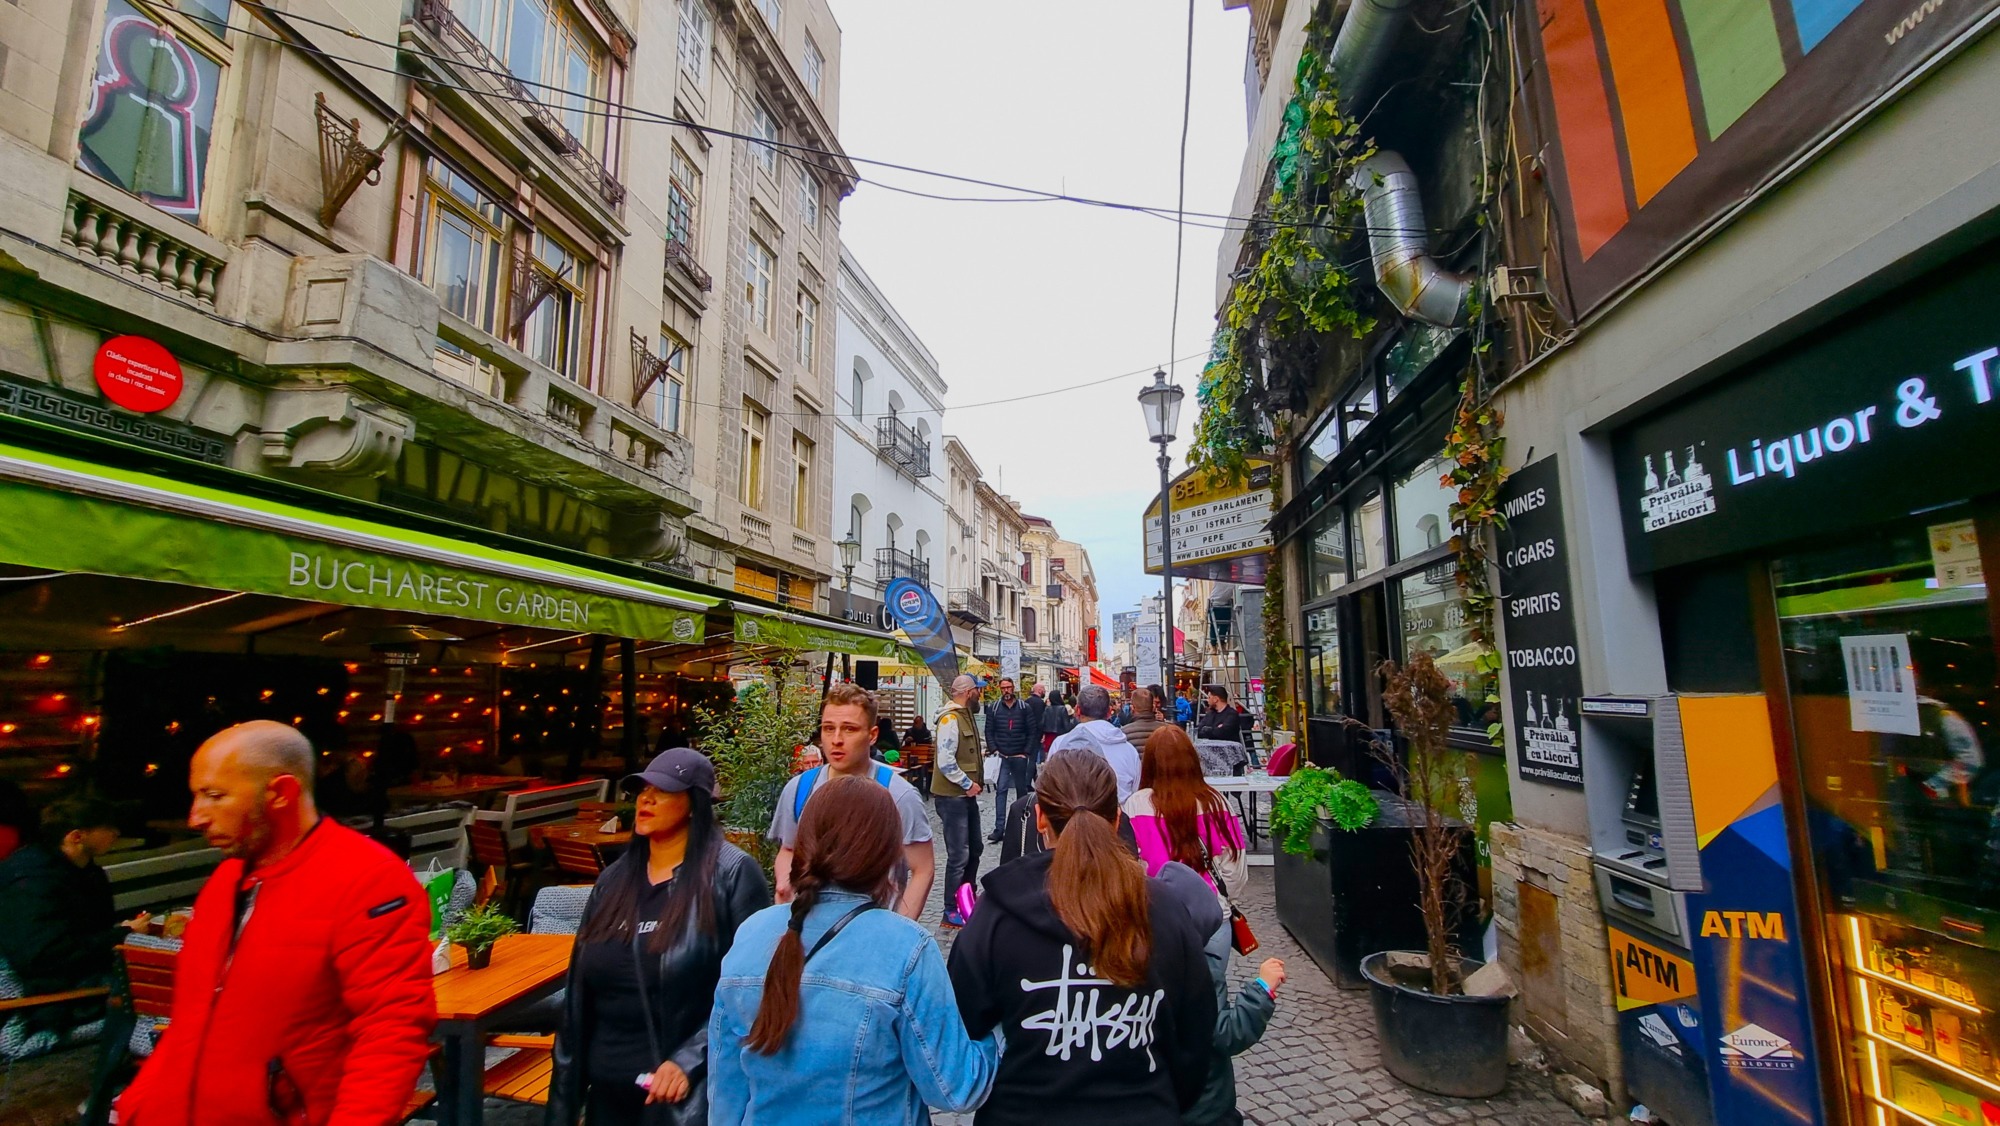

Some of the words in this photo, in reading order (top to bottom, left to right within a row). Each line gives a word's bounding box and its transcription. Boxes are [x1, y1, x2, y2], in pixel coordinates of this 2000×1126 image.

[115, 374, 130, 384] clasa
[134, 380, 144, 389] risc
[144, 384, 166, 396] seismic
[1726, 404, 1877, 486] Liquor
[1896, 377, 1942, 428] &
[1953, 346, 2000, 405] T
[1504, 487, 1546, 520] WINES
[1649, 482, 1704, 508] Prăvălia
[1171, 513, 1181, 524] 29
[1191, 508, 1207, 518] RED
[1213, 494, 1264, 513] PARLAMENT
[1651, 517, 1666, 528] cu
[1668, 500, 1708, 522] Licori
[1185, 525, 1198, 534] ADI
[1206, 513, 1242, 528] ISTRATE
[1177, 540, 1187, 550] 24
[1203, 533, 1224, 544] PEPE
[1506, 538, 1555, 568] CIGARS
[288, 552, 490, 610] BUCHAREST
[495, 587, 589, 624] GARDEN
[1511, 592, 1560, 618] SPIRITS
[1509, 645, 1576, 668] TOBACCO
[1531, 750, 1542, 759] cu
[1543, 750, 1573, 764] Licori
[1701, 910, 1785, 941] ATM
[1626, 941, 1681, 994] ATM
[1644, 1017, 1674, 1043] Euronet
[1731, 1034, 1779, 1048] Euronet
[1721, 1058, 1795, 1069] WORLDWIDE
